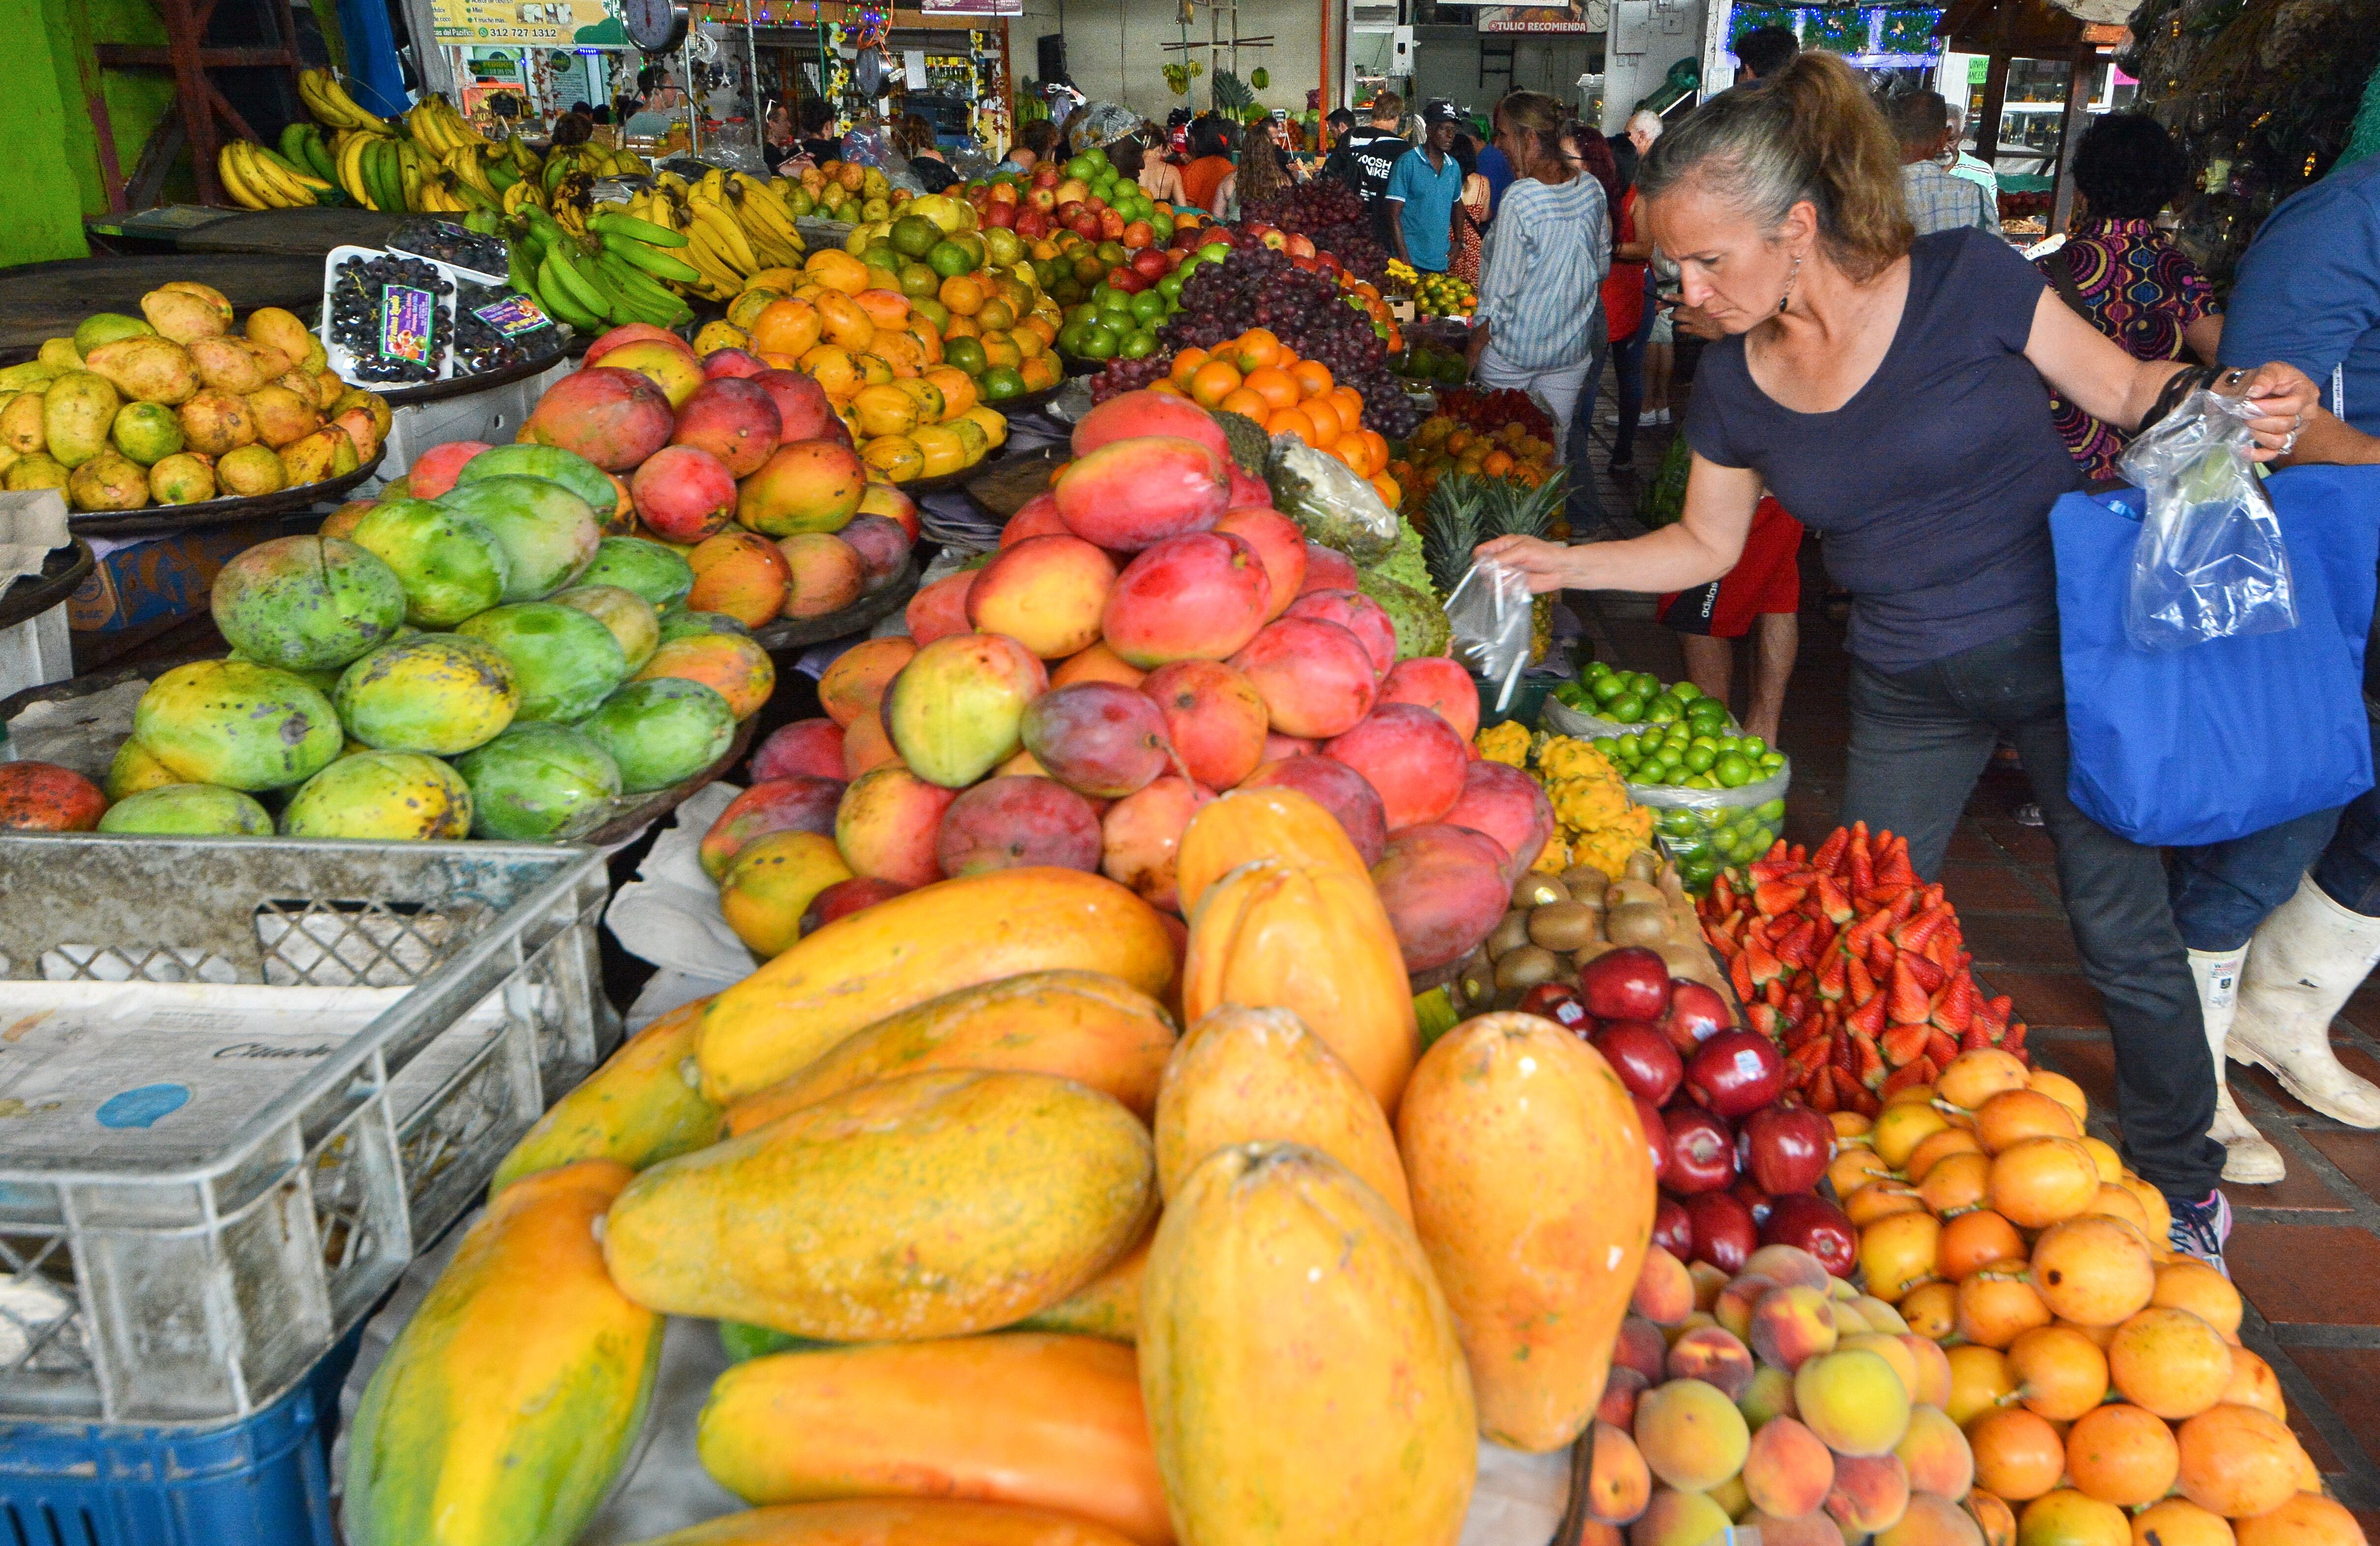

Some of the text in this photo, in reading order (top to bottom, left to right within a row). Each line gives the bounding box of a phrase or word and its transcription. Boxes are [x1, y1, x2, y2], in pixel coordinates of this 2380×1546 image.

[1489, 22, 1586, 31] @TULIO RECOMIENDA
[1701, 582, 1718, 617] adidas
